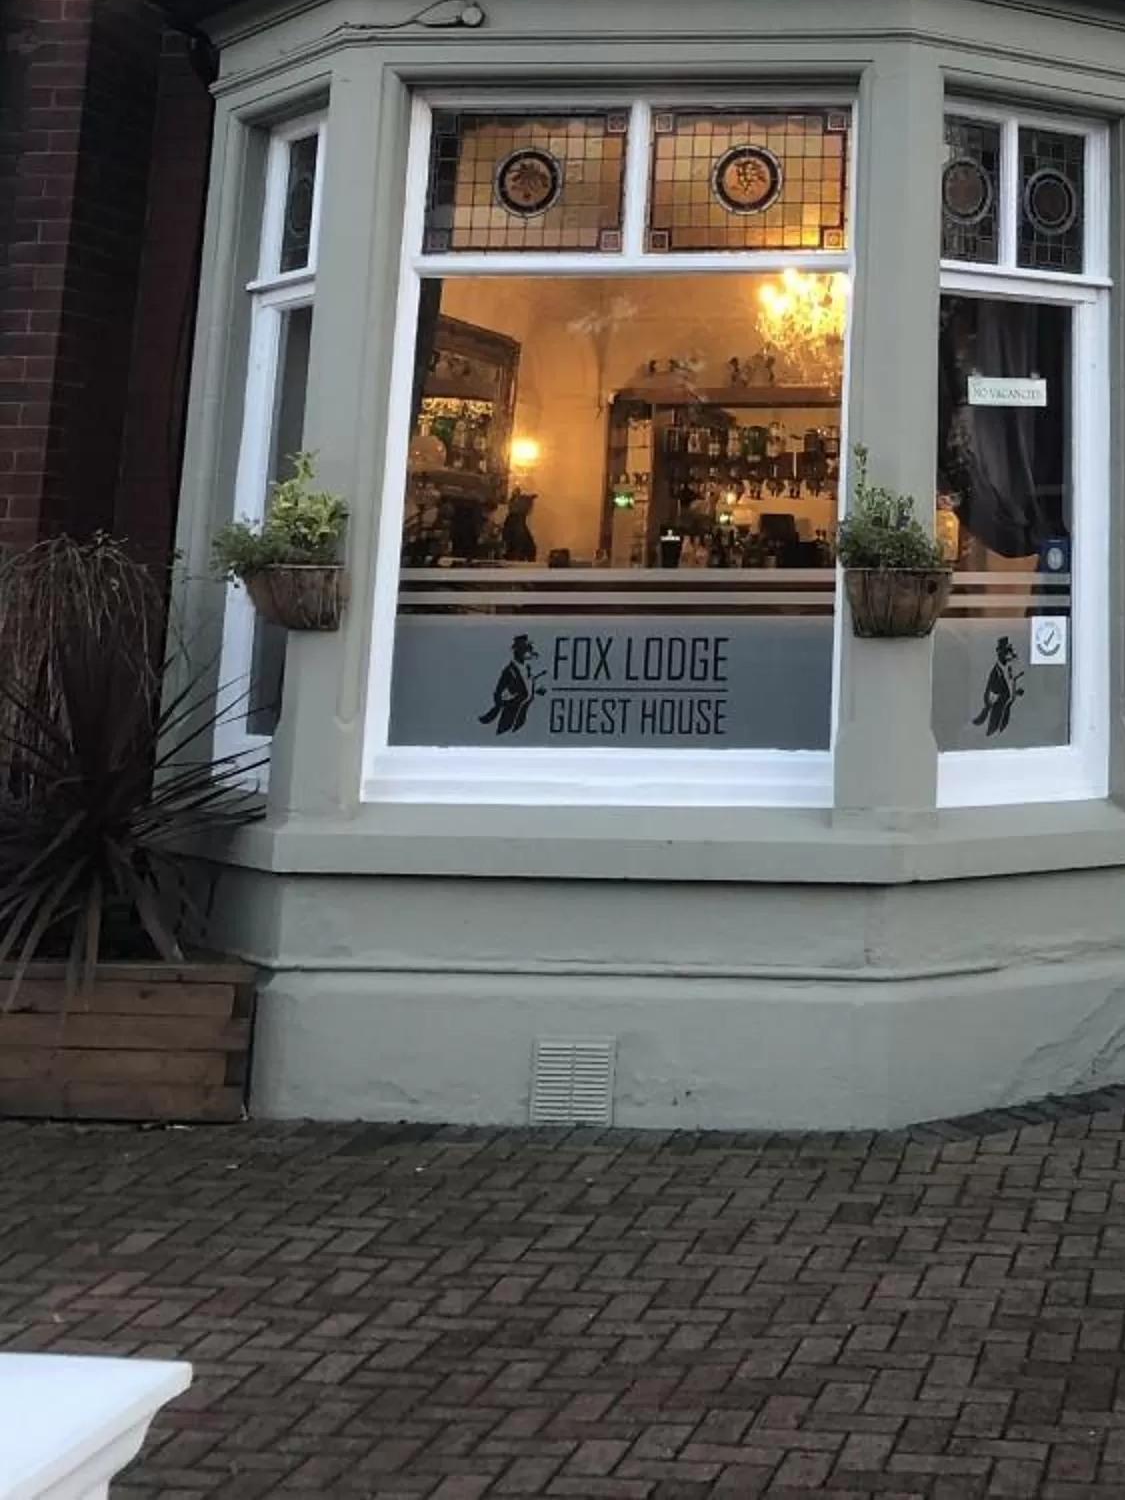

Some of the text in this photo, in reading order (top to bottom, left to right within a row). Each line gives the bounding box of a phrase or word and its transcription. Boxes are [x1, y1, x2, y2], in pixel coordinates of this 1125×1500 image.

[553, 636, 729, 681] FOX LODGE
[549, 697, 728, 735] GUEST HOUSE
